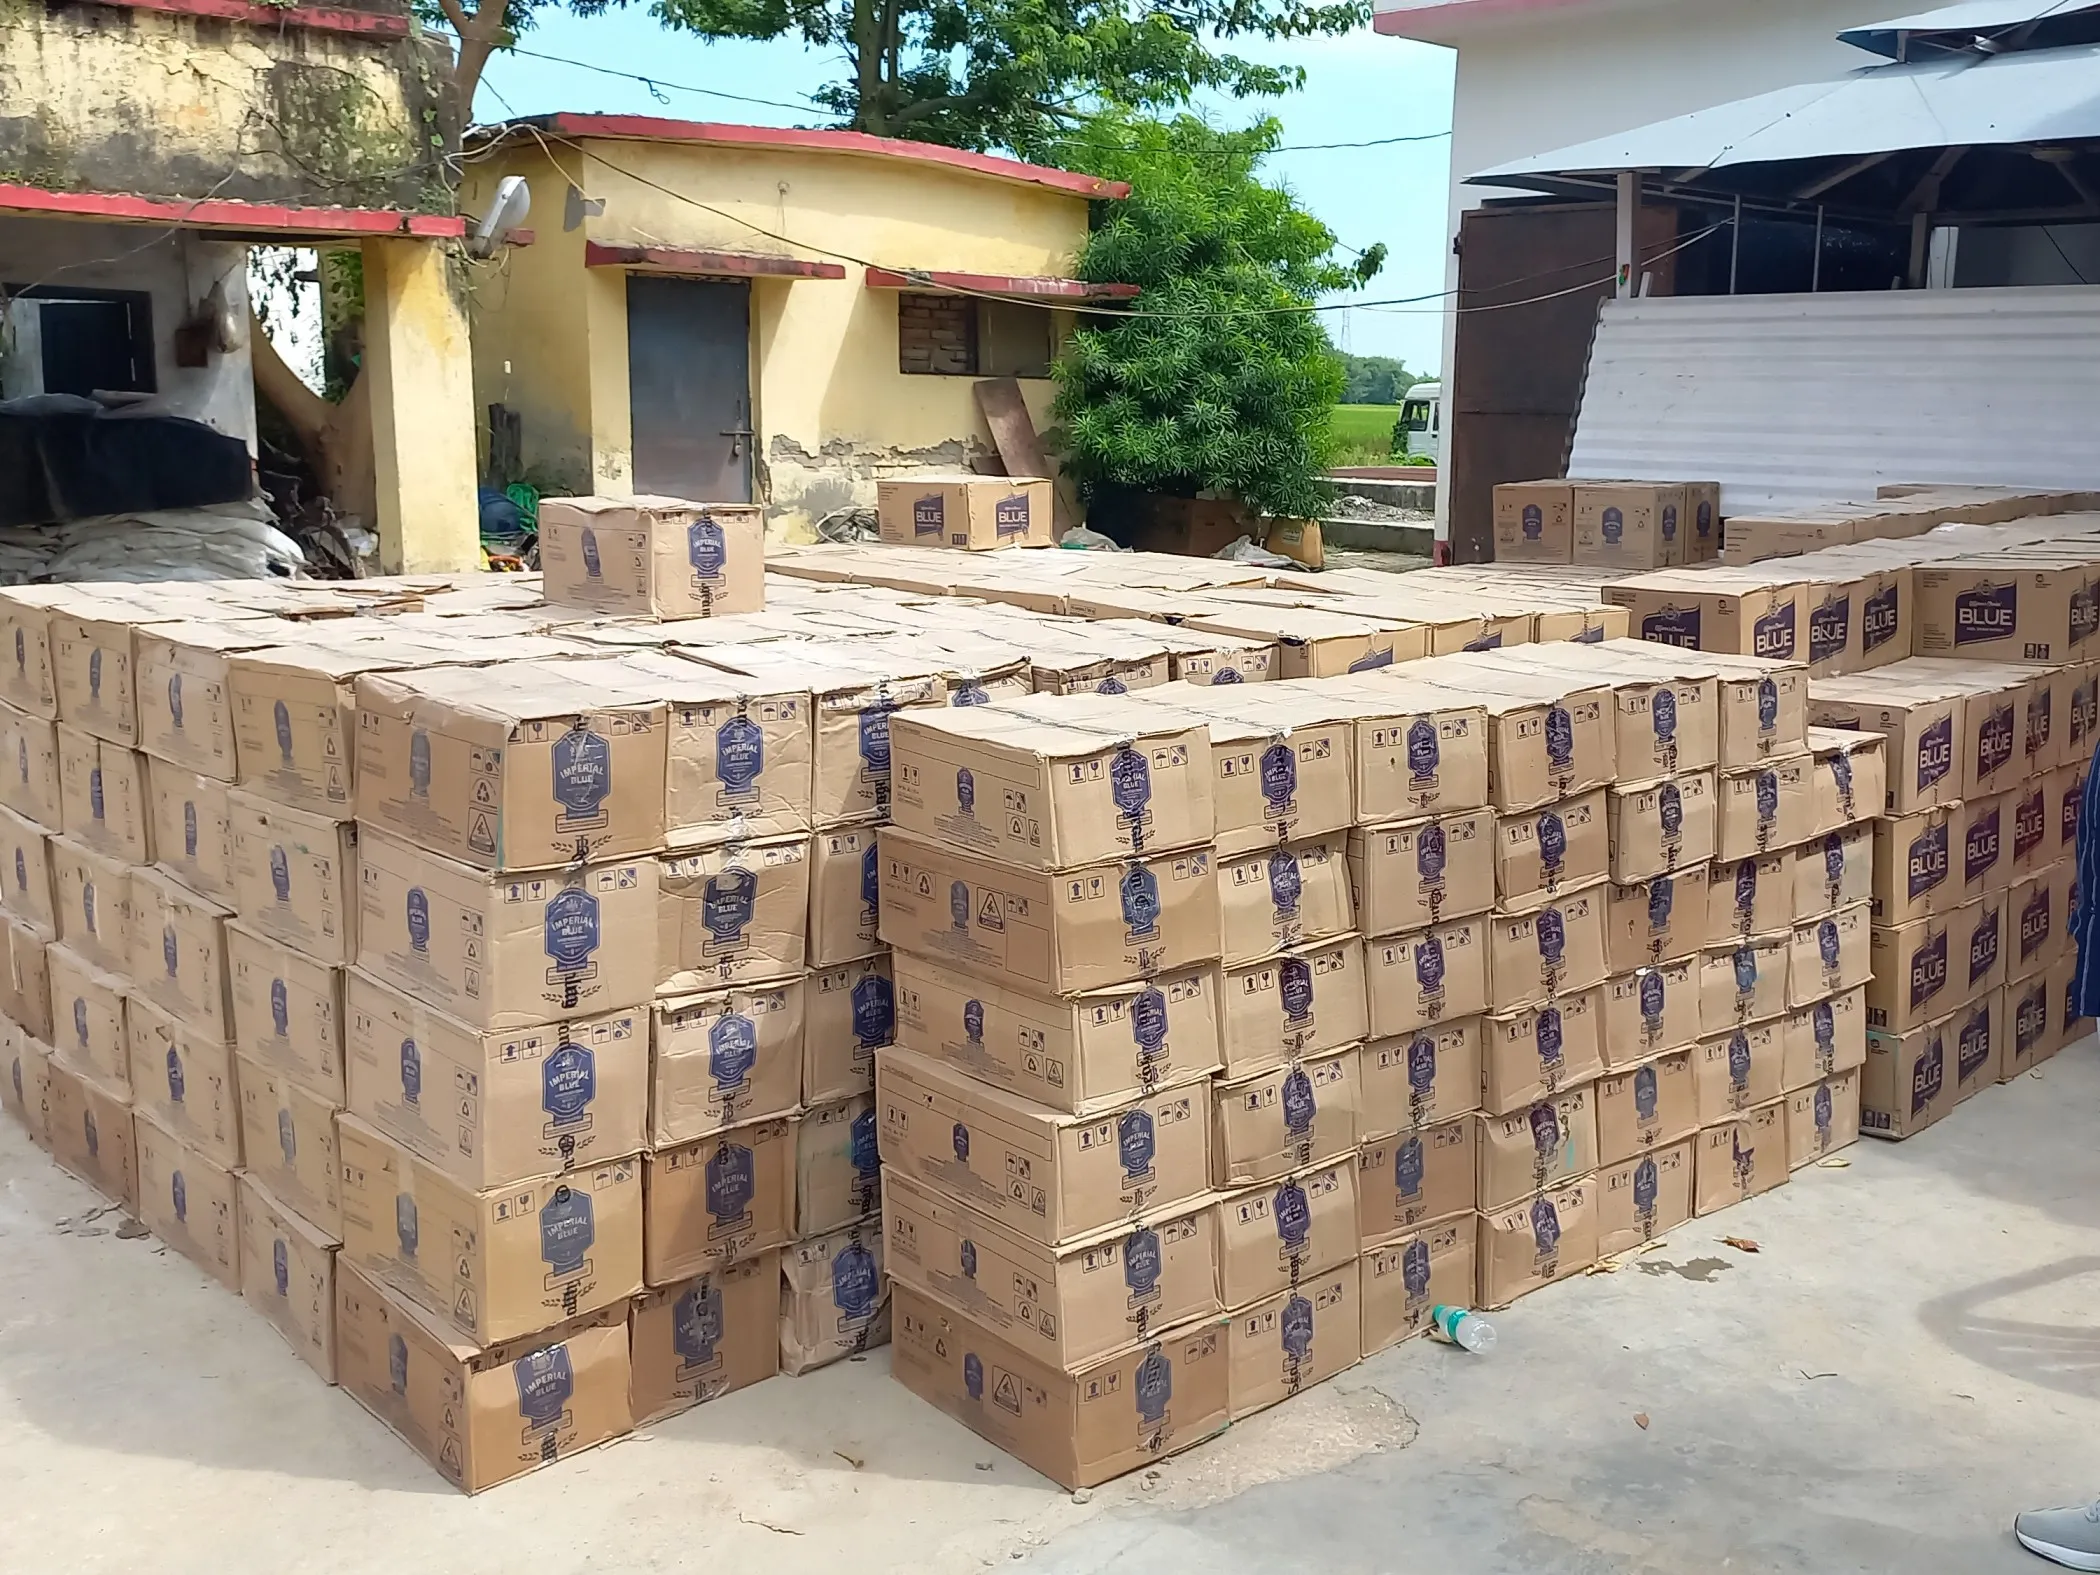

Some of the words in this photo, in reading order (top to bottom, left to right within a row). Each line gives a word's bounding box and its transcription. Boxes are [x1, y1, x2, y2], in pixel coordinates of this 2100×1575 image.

[916, 511, 942, 523] BLUE
[999, 511, 1027, 523] BLUE
[1864, 609, 1896, 632] BLUE
[1959, 608, 2013, 626] BLUE
[1756, 628, 1793, 653] BLUE
[1811, 622, 1846, 643] BLUE
[864, 722, 889, 736] IMPER
[722, 743, 758, 757] IMPERIAL
[1980, 732, 2012, 757] BLUE
[730, 753, 750, 761] BLUE
[1920, 743, 1950, 769] BLUE
[560, 762, 604, 779] IMPERIAL
[571, 775, 594, 785] BLUE
[1123, 780, 1139, 789] BLUE
[2015, 814, 2043, 840] BLUE
[1967, 834, 1998, 861] BLUE
[1910, 851, 1946, 877] BLUE
[718, 904, 738, 913] BLUE
[552, 915, 594, 932] IMPERIAL
[562, 927, 583, 936] BLUE
[2022, 912, 2048, 938] BLUE
[1972, 935, 1996, 963] BLUE
[1913, 959, 1945, 986] BLUE
[1961, 1032, 1988, 1061] BLUE
[549, 1070, 590, 1088] IMPERIAL
[559, 1081, 581, 1091] BLUE
[1914, 1064, 1940, 1092] BLUE
[1123, 1132, 1150, 1146] IMPERIAL
[711, 1174, 748, 1192] IMPERIAL
[547, 1215, 588, 1237] IMPERIAL
[557, 1228, 578, 1240] BLUE
[1128, 1250, 1156, 1266] IMPERIAL
[525, 1371, 567, 1395] IMPERIAL
[535, 1382, 557, 1397] BLUE
